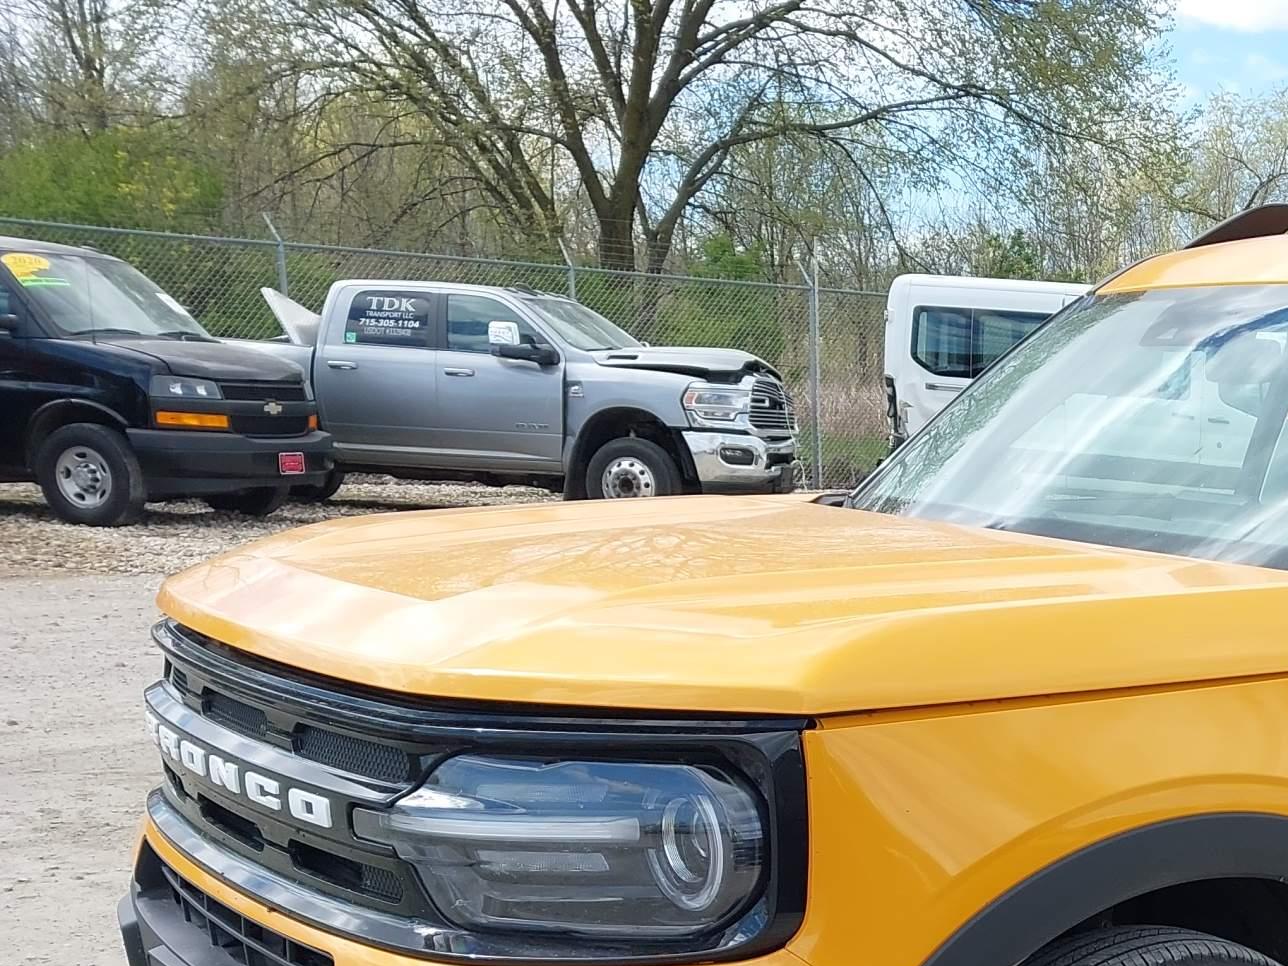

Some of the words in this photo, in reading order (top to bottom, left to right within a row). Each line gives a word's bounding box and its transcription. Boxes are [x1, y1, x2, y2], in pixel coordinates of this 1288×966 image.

[366, 296, 417, 312] TDK
[365, 310, 402, 318] TRANSPORT
[359, 318, 420, 328] 715-305-1104
